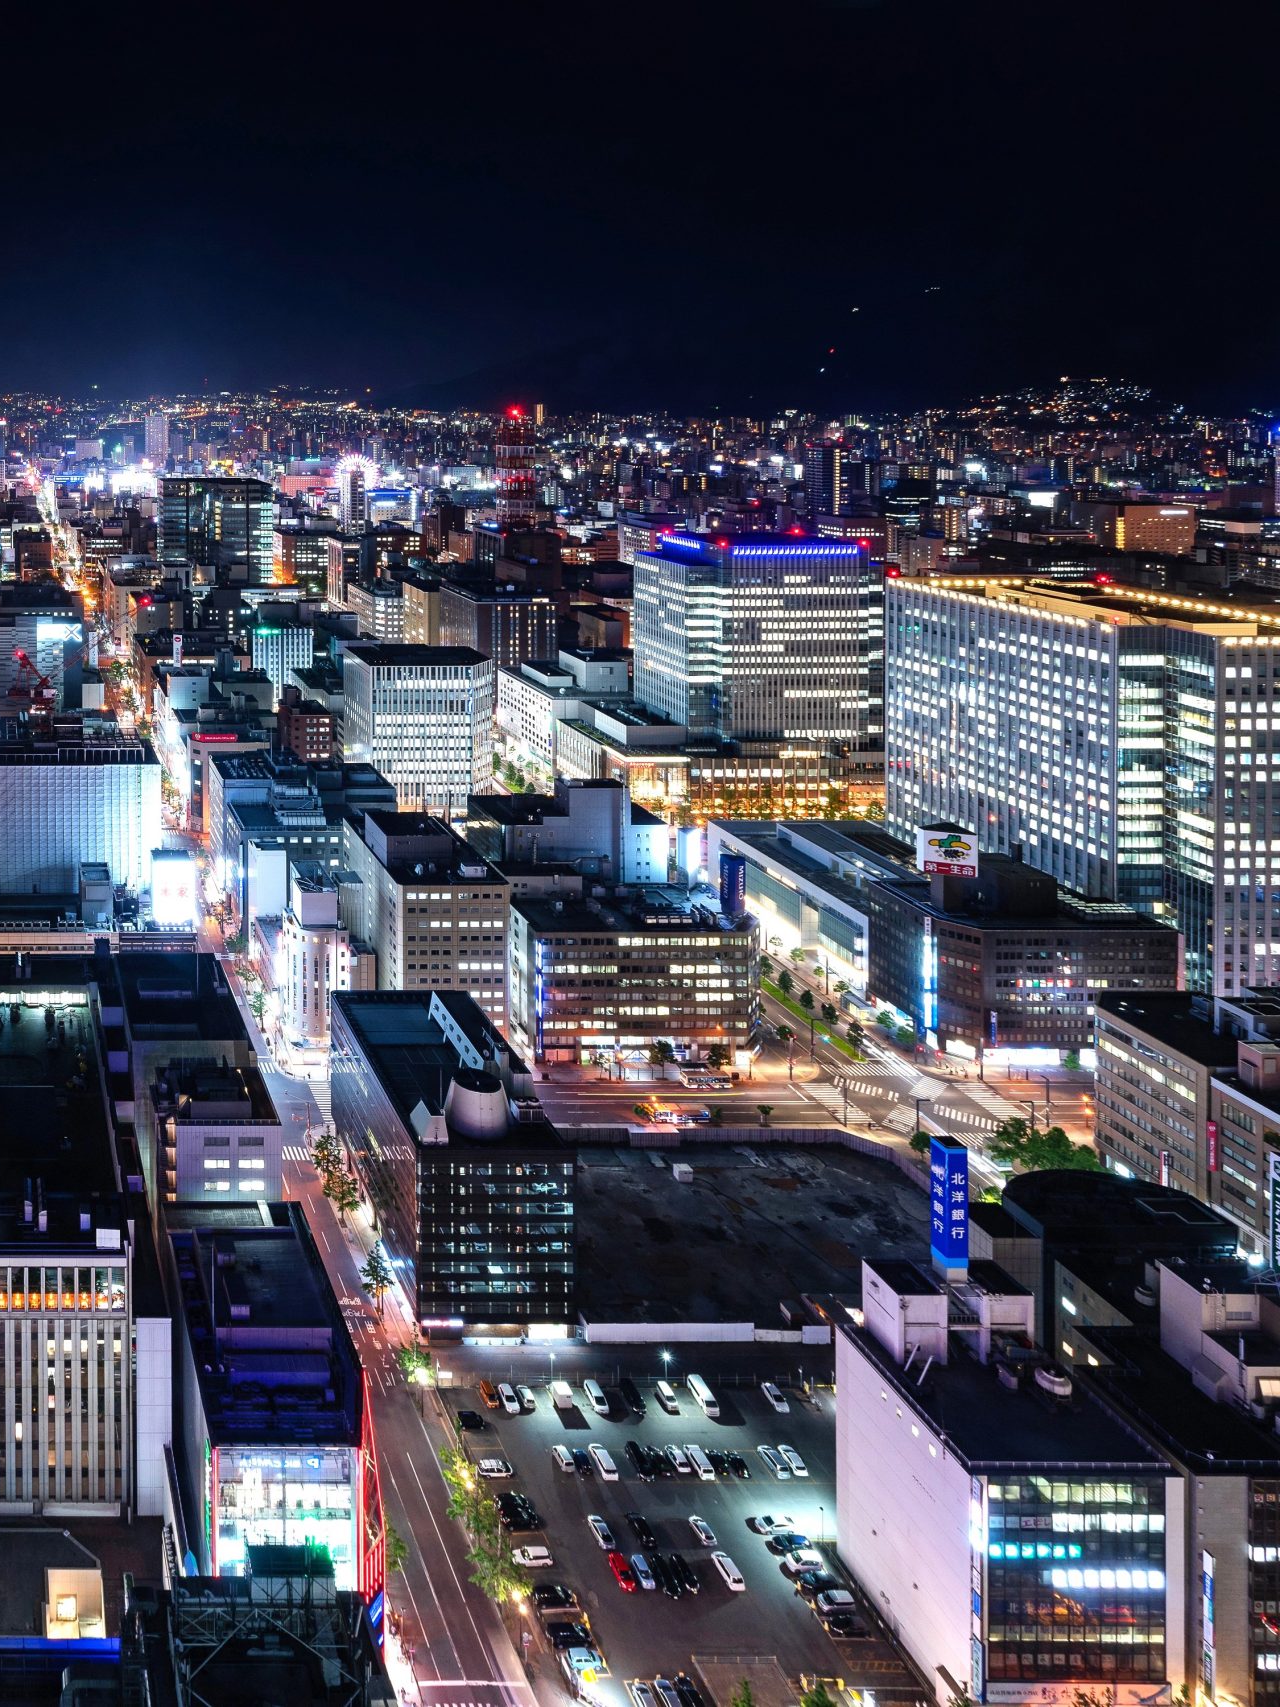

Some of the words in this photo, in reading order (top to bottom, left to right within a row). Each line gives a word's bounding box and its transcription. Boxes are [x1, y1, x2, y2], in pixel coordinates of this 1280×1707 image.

[925, 862, 974, 876] 第一生命
[951, 1172, 965, 1239] 北洋銀行
